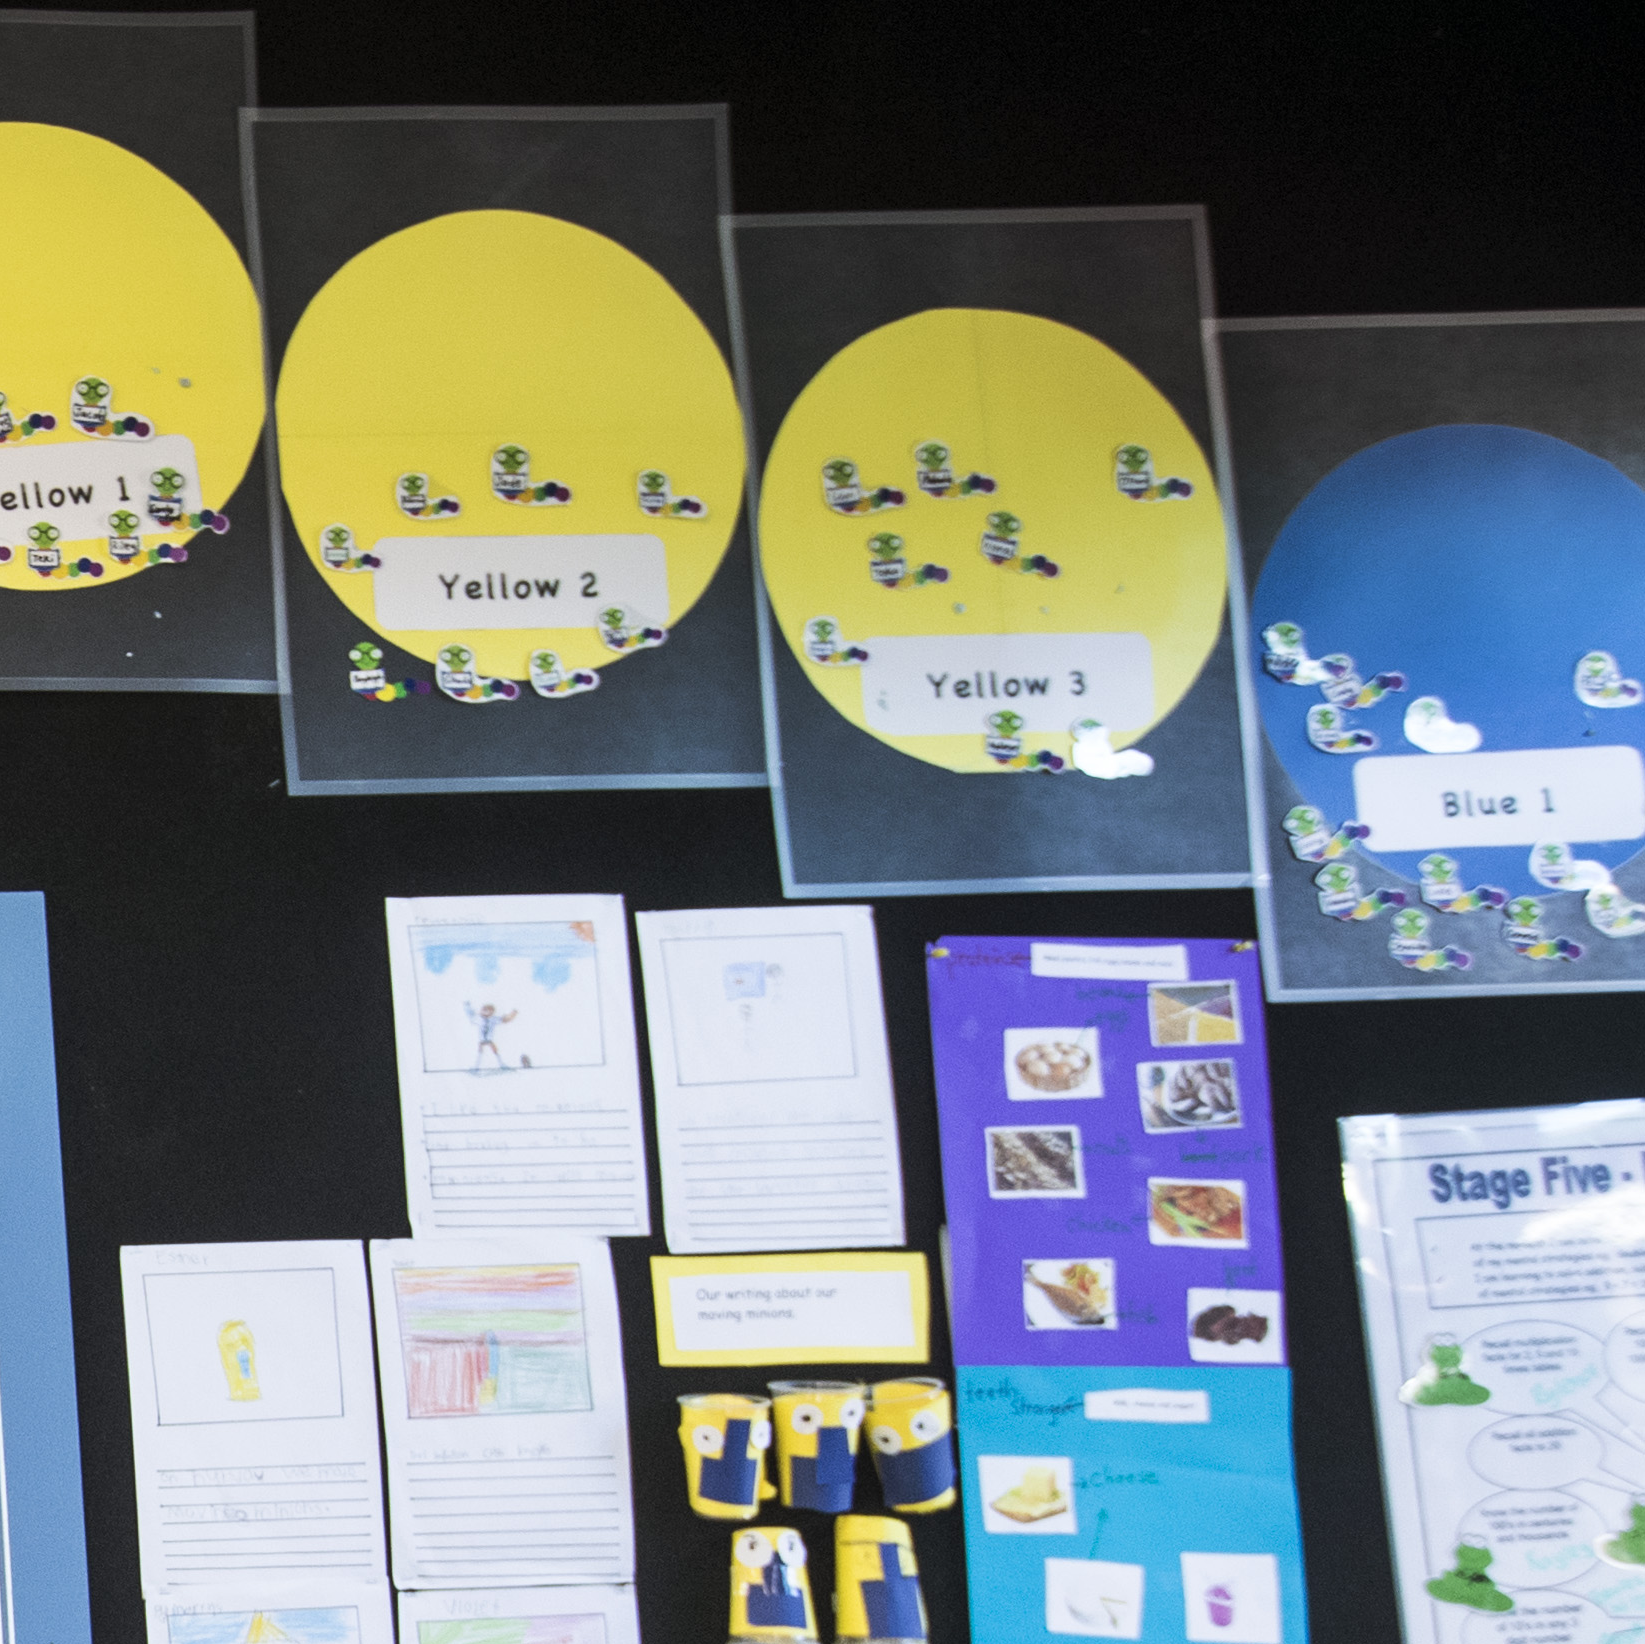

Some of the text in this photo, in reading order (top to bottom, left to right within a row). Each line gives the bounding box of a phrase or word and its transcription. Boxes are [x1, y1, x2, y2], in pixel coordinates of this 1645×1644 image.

[118, 477, 130, 501] 1
[440, 572, 598, 599] Yellow 2
[927, 671, 1085, 698] Yellow 3
[1443, 789, 1554, 817] Blue 1
[1428, 1162, 1531, 1211] Stage
[1541, 1156, 1611, 1195] Five
[696, 1285, 837, 1305] Our writing about our
[696, 1308, 742, 1324] moving
